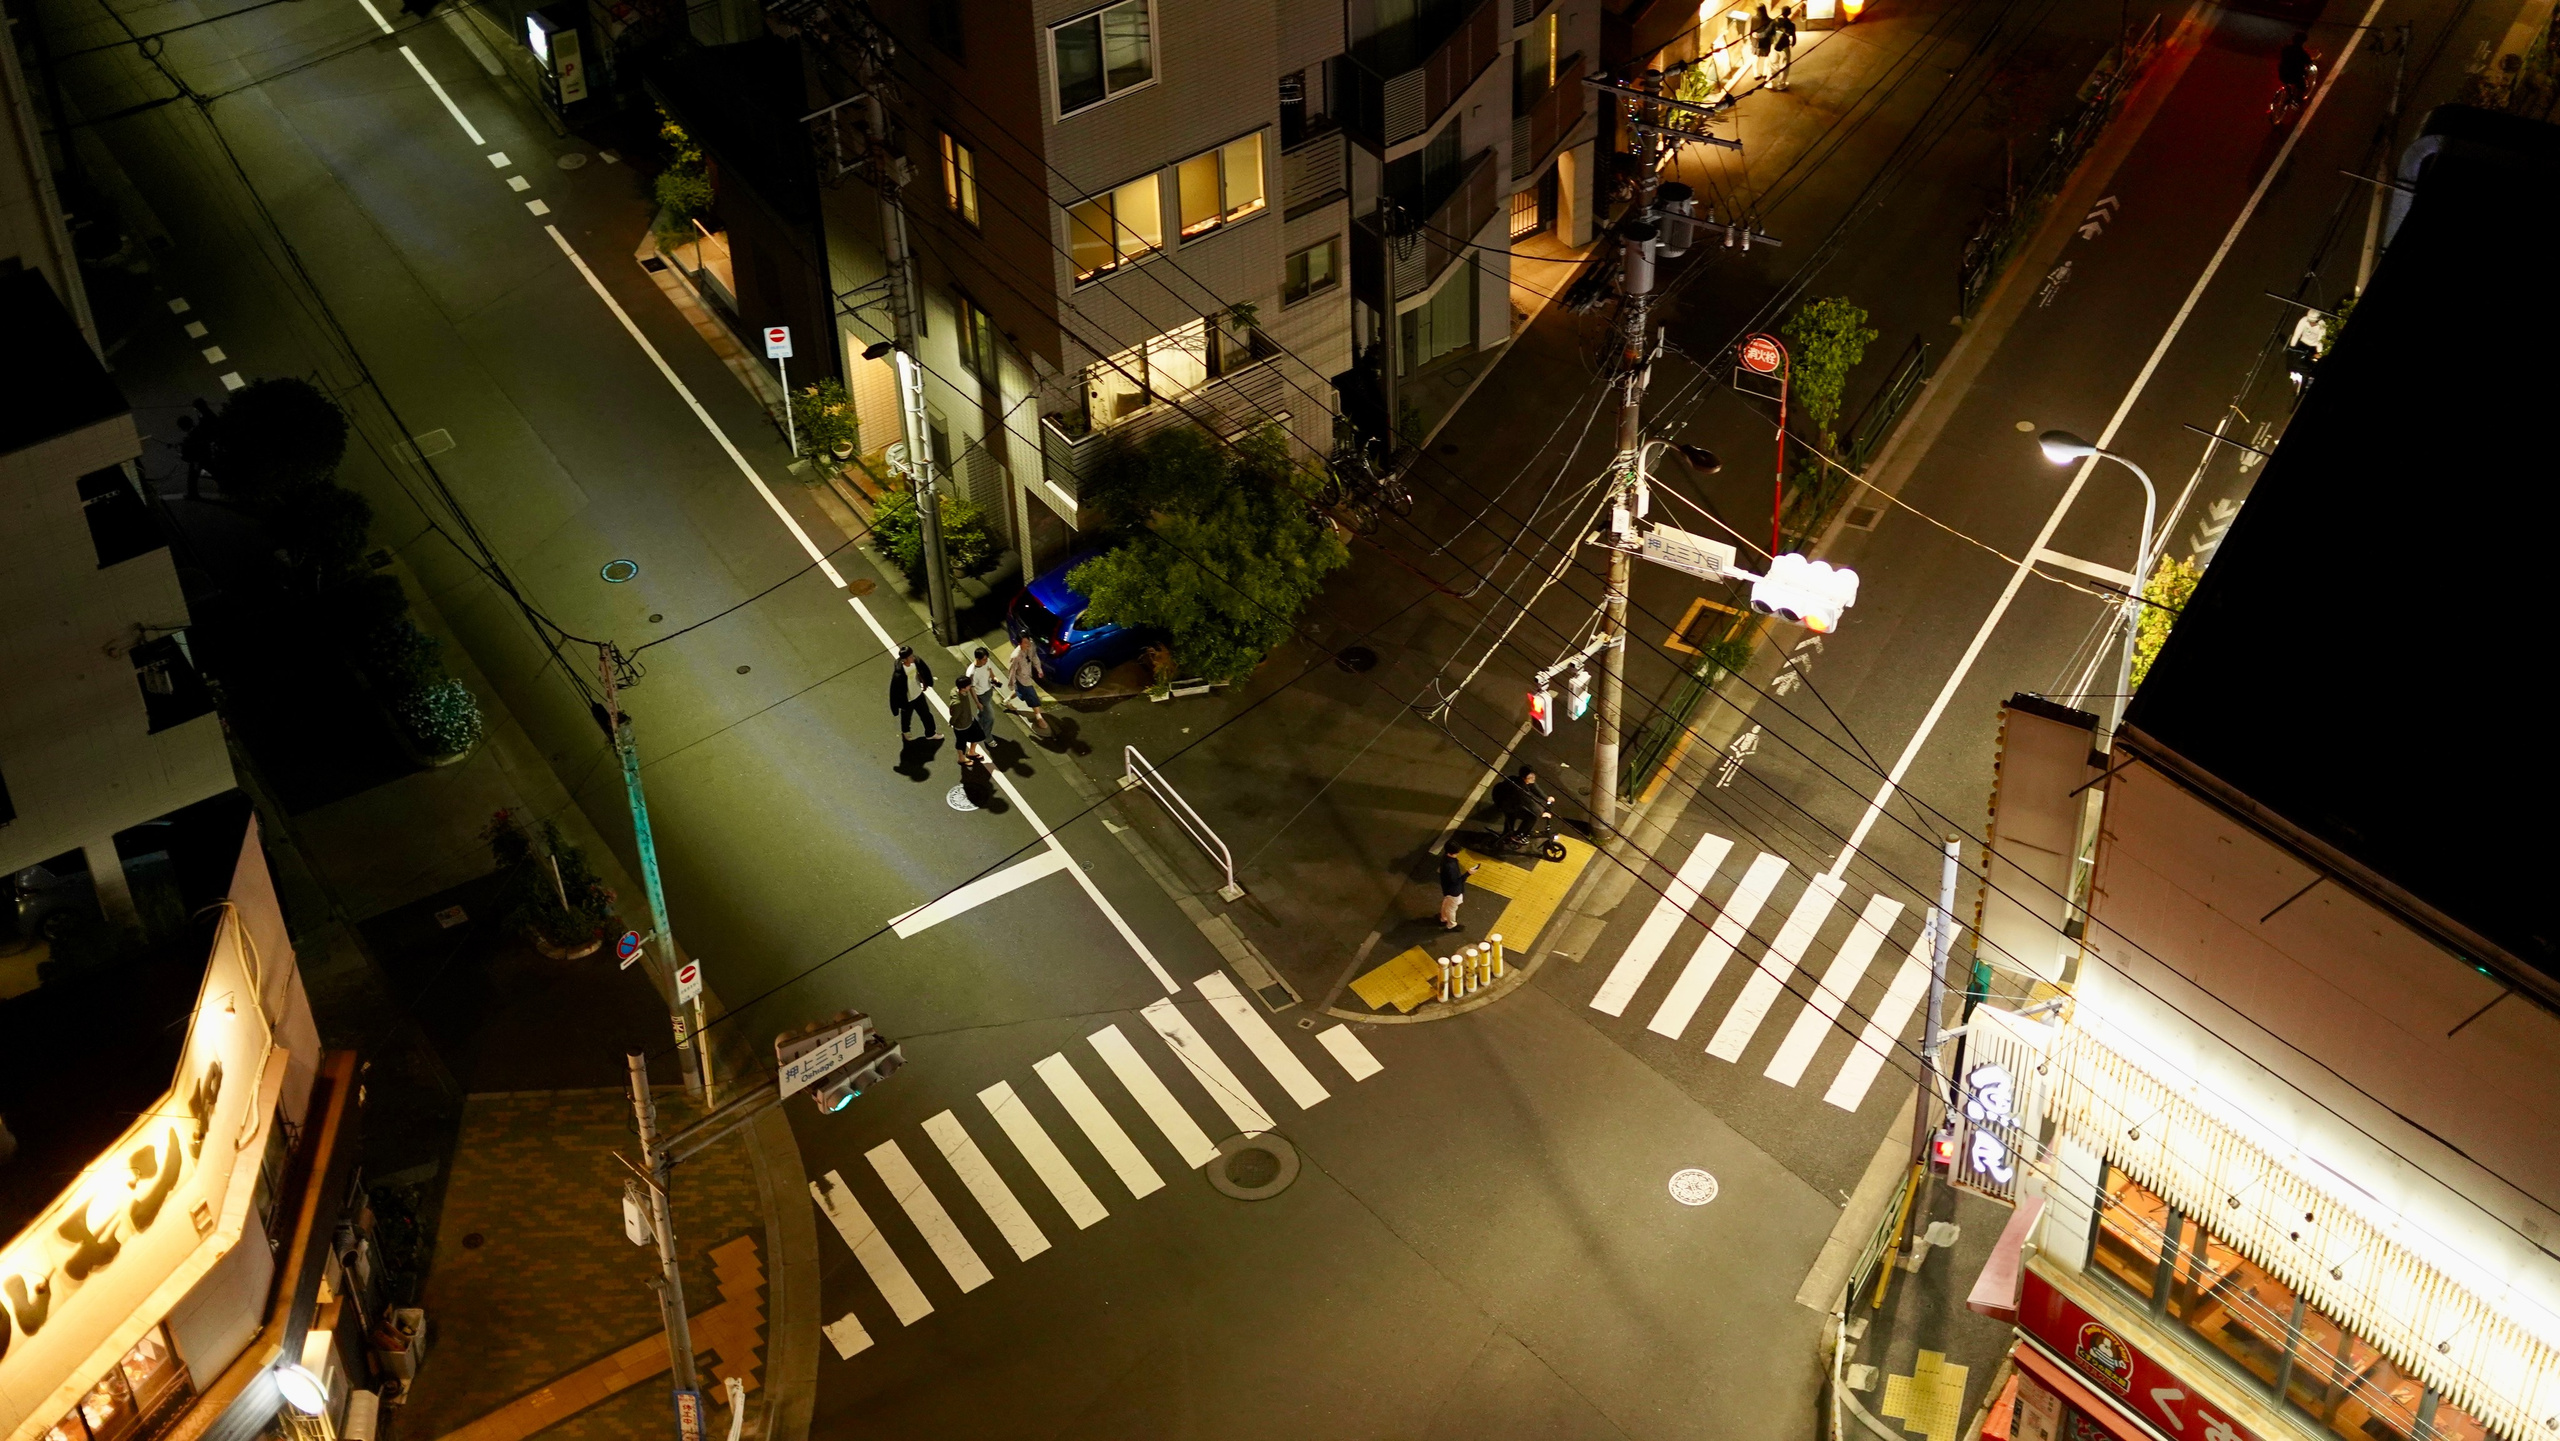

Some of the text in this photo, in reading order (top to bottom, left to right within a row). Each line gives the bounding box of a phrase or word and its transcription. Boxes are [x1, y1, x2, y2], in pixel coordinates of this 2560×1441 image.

[1747, 347, 1777, 365] 消火栓
[1647, 538, 1719, 571] 押上三丁目
[785, 1032, 857, 1083] 押上三丁目
[801, 1054, 844, 1083] Oshiage 3
